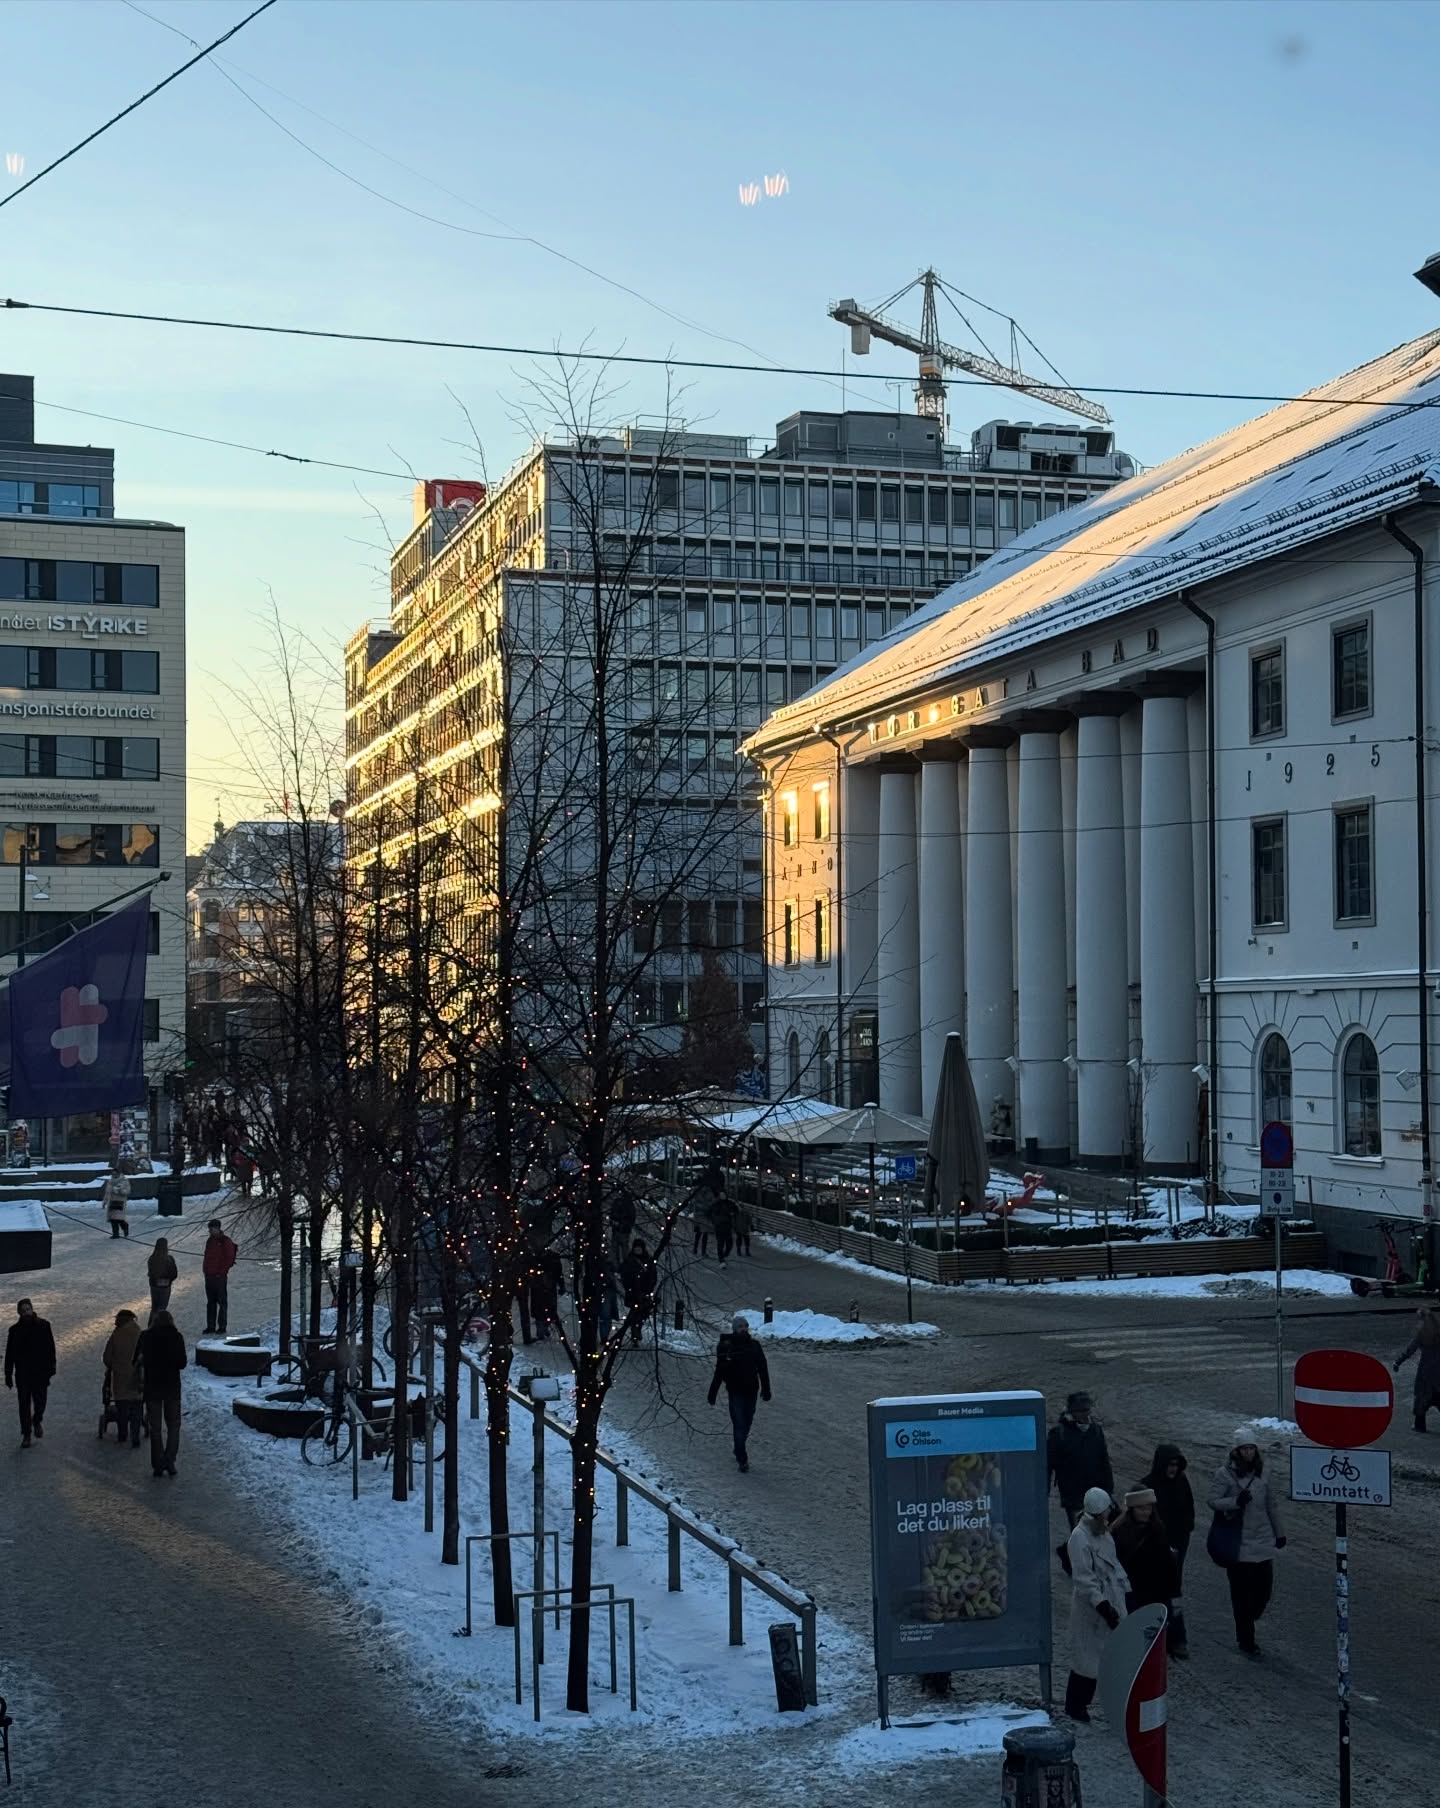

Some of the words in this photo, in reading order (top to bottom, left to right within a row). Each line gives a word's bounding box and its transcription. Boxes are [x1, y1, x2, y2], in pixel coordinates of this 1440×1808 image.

[1082, 628, 1160, 674] BAD
[0, 702, 156, 719] nsjonistforbundet
[1245, 744, 1381, 791] 1925
[938, 1408, 960, 1416] Bauer
[912, 1438, 942, 1446] Ohlson
[1312, 1483, 1371, 1500] Unntatt
[897, 1500, 927, 1518] Lag
[931, 1498, 973, 1517] plass
[976, 1495, 991, 1511] til
[897, 1517, 925, 1533] det
[928, 1516, 949, 1531] du
[953, 1513, 990, 1530] liker!
